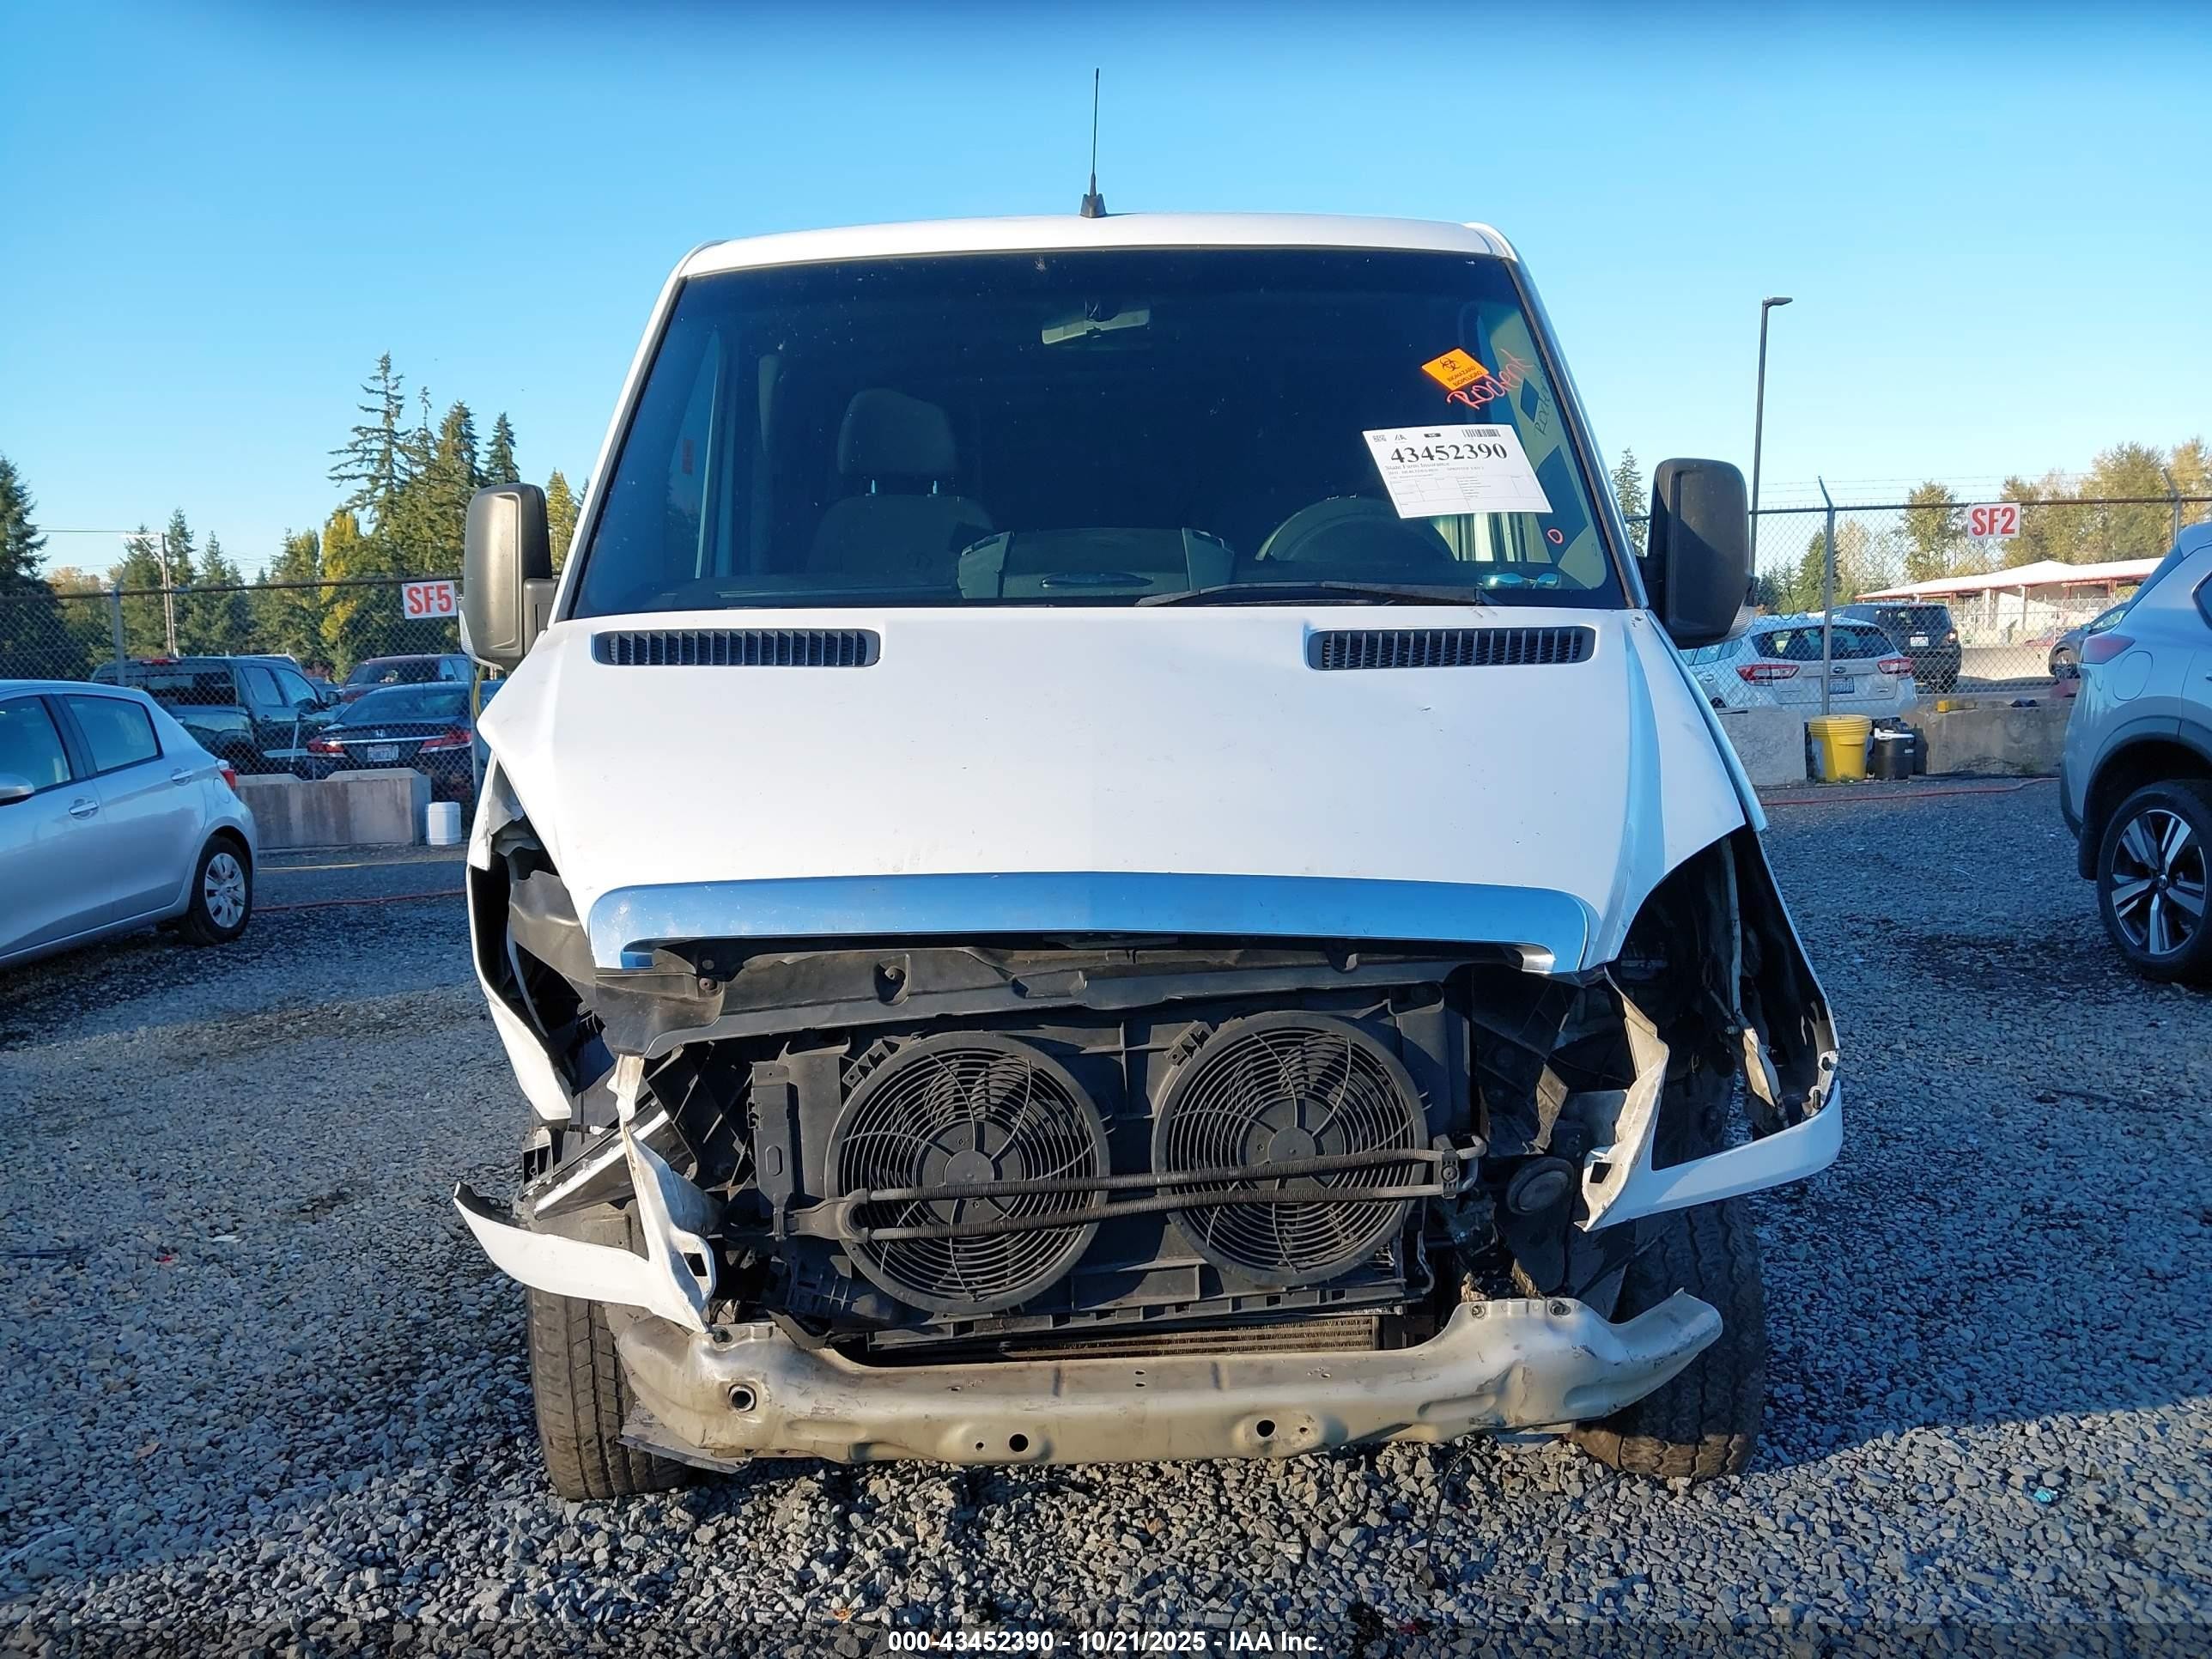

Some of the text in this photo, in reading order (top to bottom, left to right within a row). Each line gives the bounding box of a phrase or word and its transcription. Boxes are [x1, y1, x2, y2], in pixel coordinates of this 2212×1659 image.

[1390, 443, 1508, 463] 43452390
[1972, 507, 2015, 536] SF2
[407, 585, 452, 614] SF5
